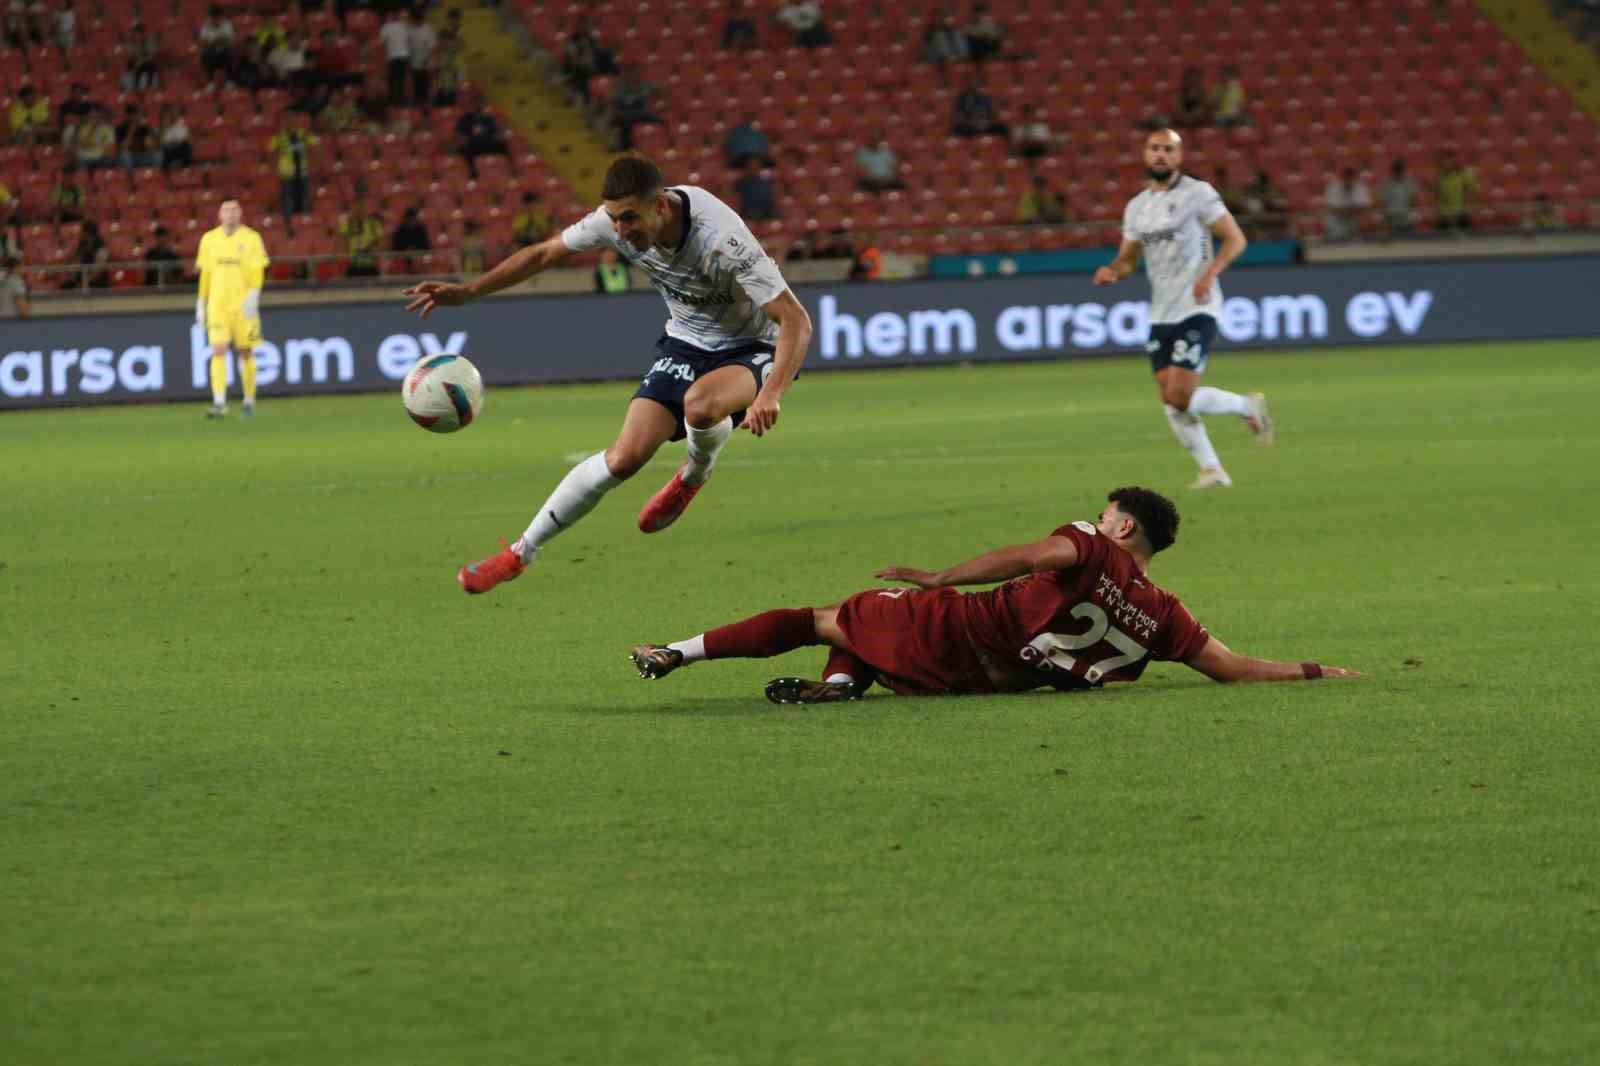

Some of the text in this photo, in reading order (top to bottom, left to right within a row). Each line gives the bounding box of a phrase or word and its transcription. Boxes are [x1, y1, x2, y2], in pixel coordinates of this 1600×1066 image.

[819, 290, 1433, 359] hem arsa em ev
[0, 345, 163, 397] arsa
[1028, 601, 1149, 684] 27
